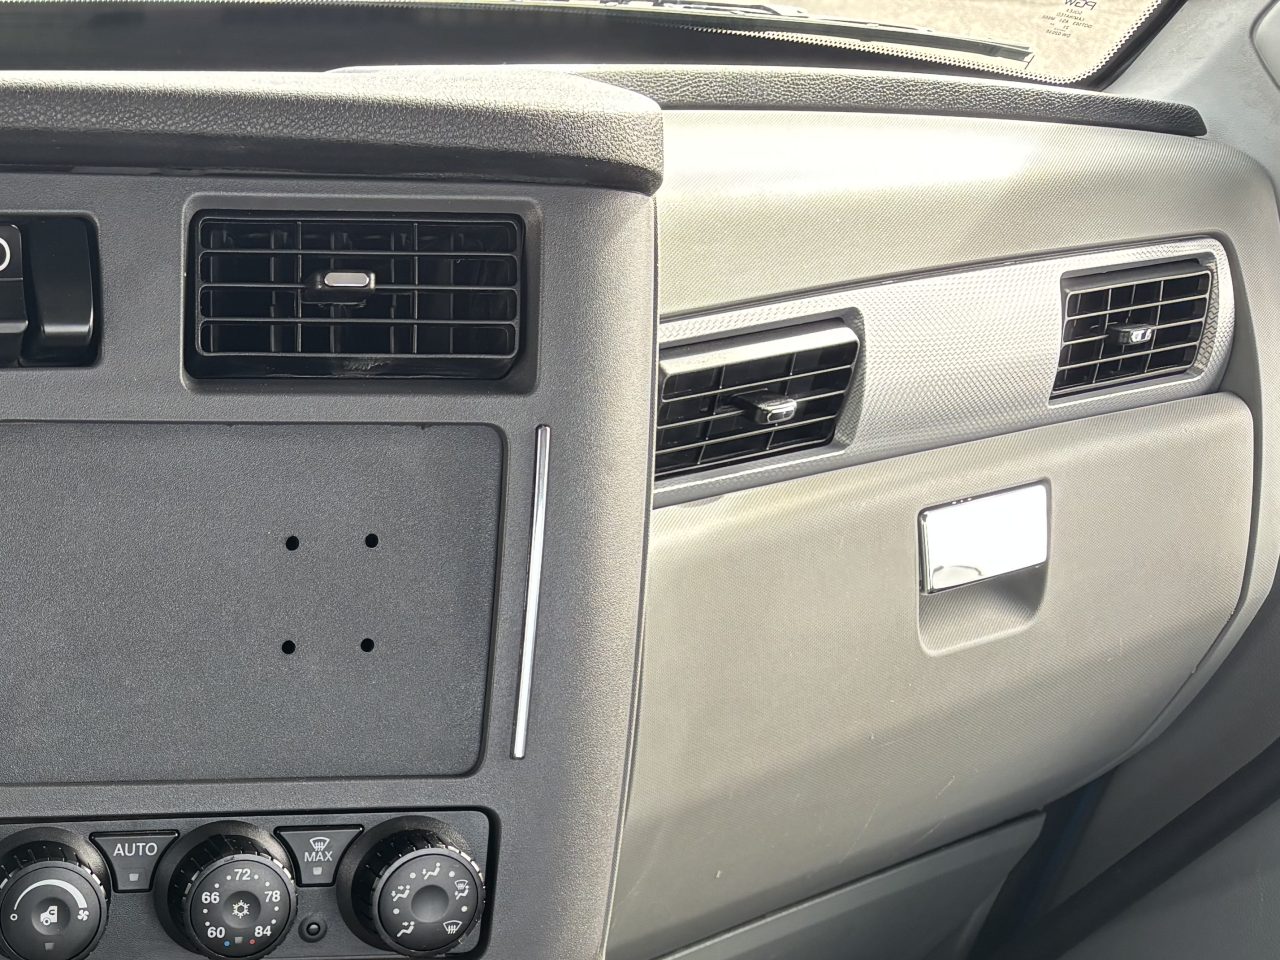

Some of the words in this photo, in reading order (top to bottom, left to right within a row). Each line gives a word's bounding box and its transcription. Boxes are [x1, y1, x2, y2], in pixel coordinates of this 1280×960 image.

[113, 842, 158, 857] AUTO
[304, 850, 333, 863] MAX
[233, 868, 251, 881] 72
[201, 891, 220, 904] 66
[264, 890, 281, 903] 78
[207, 926, 225, 939] 60
[254, 925, 272, 938] 84
